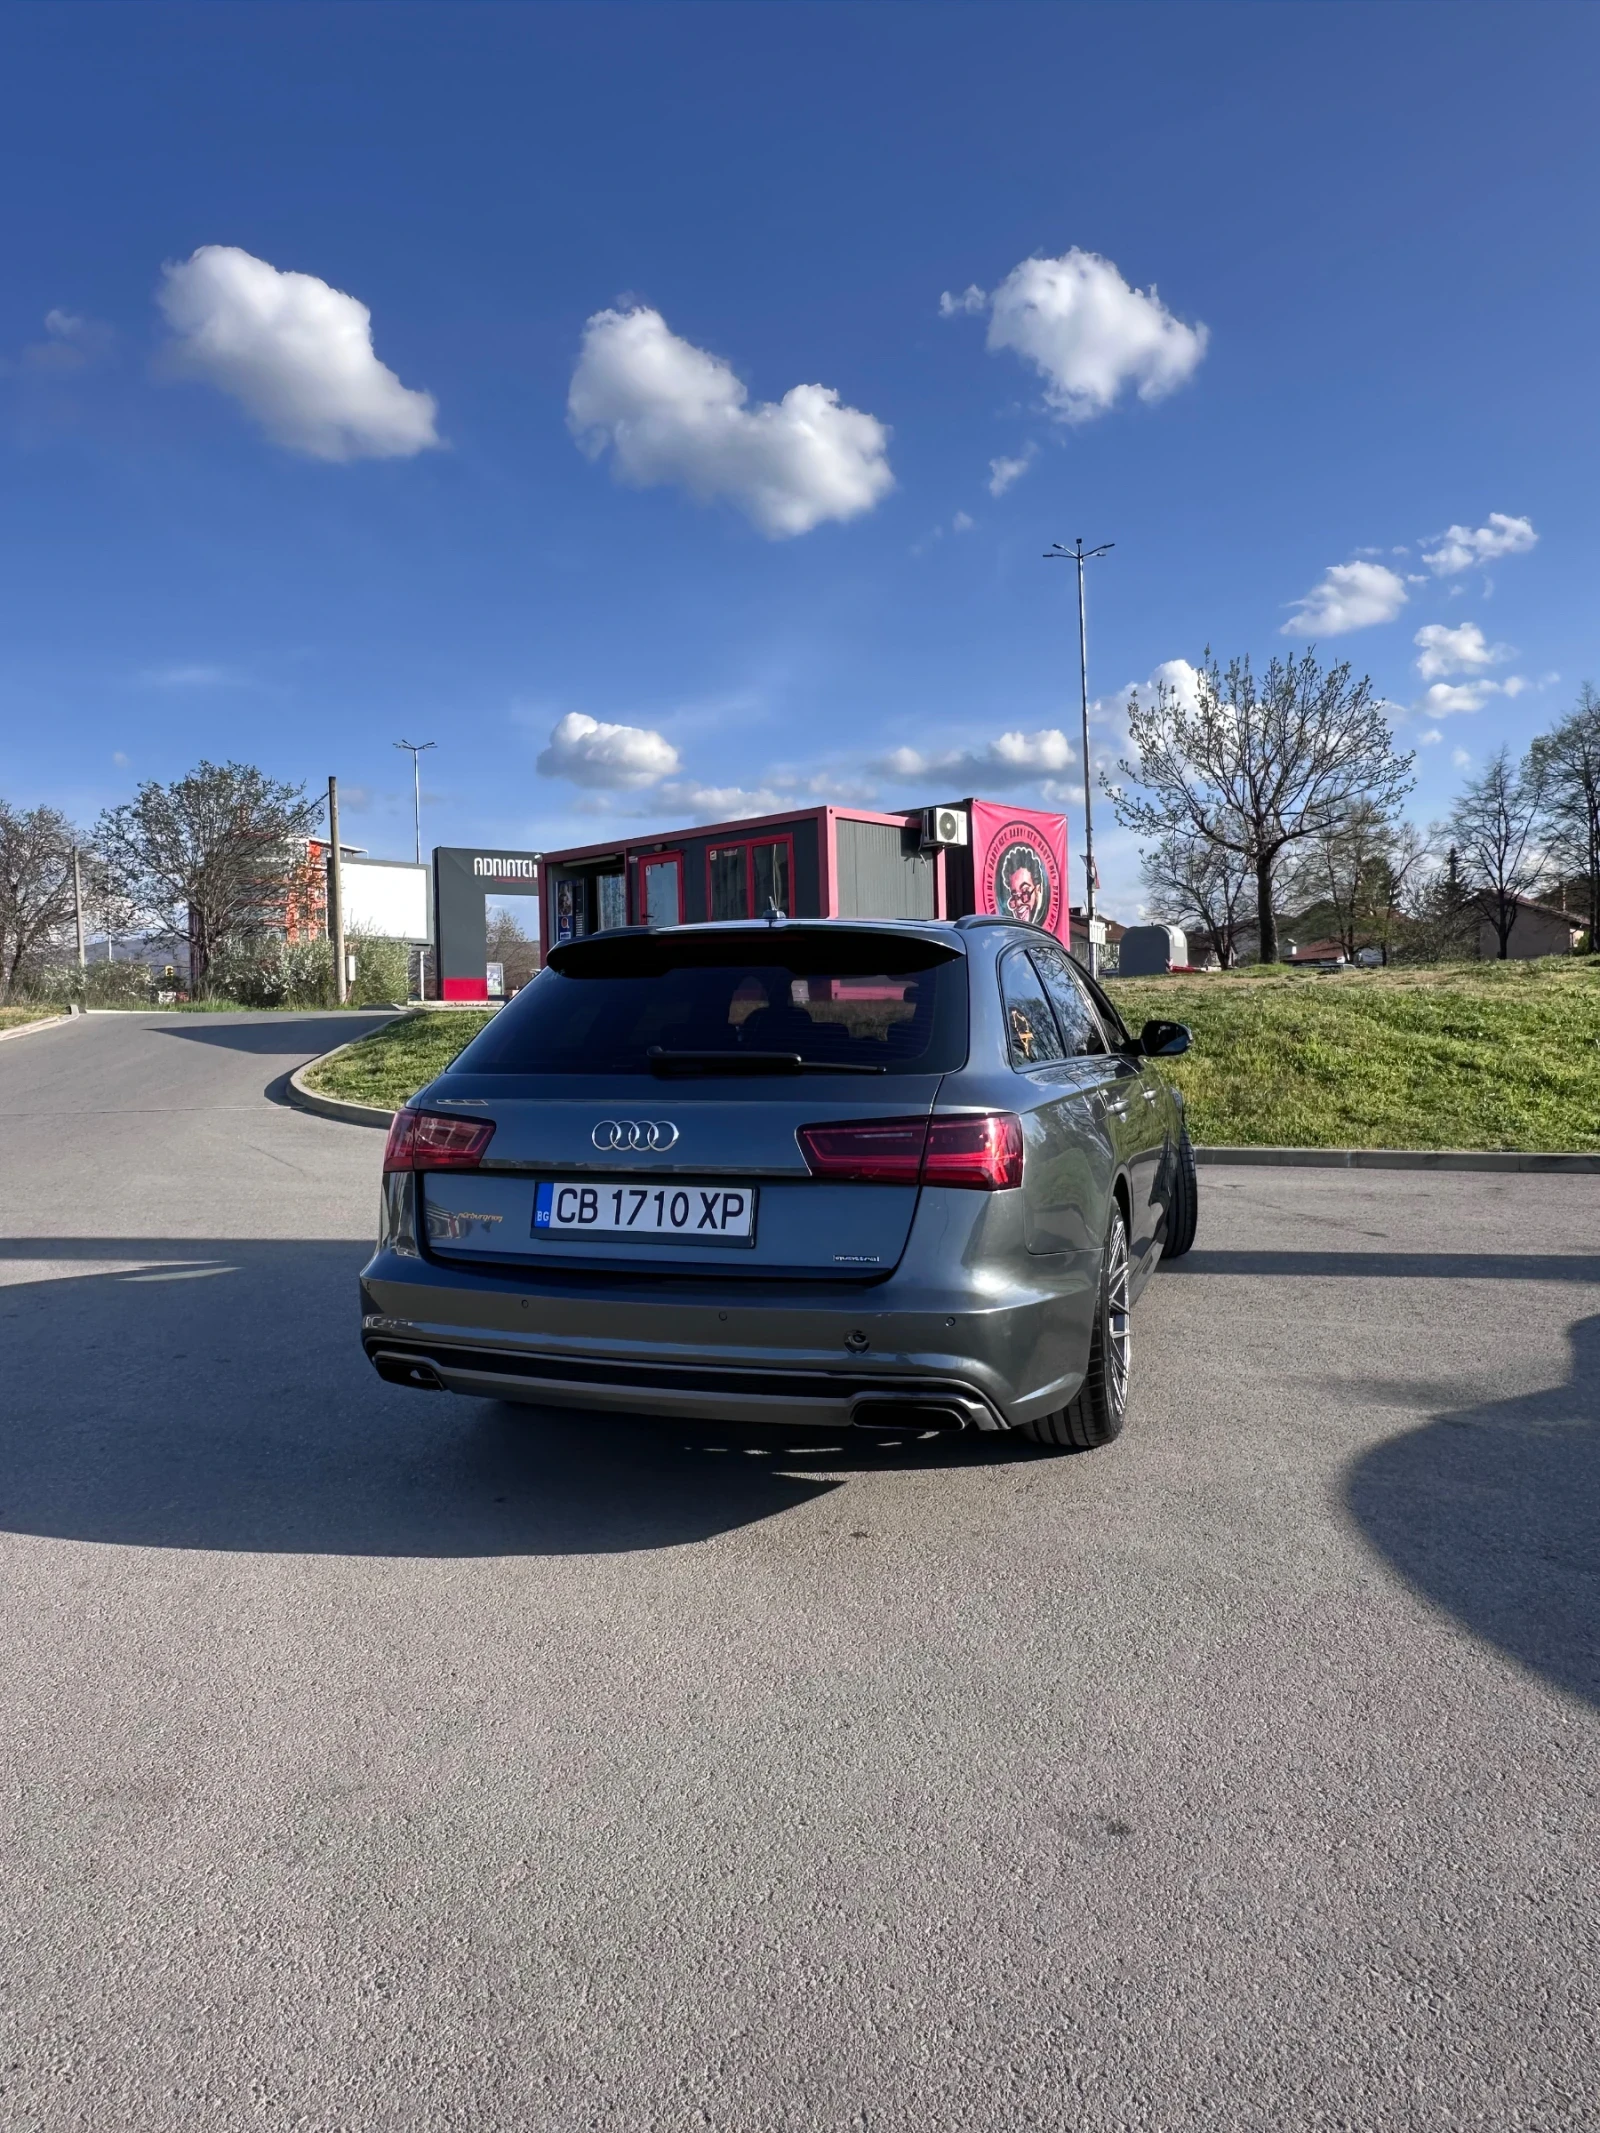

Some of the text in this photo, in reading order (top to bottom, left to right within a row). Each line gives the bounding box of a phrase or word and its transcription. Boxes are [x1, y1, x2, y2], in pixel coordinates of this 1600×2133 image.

[536, 1210, 550, 1222] BG
[556, 1187, 745, 1230] CB 1710 XP
